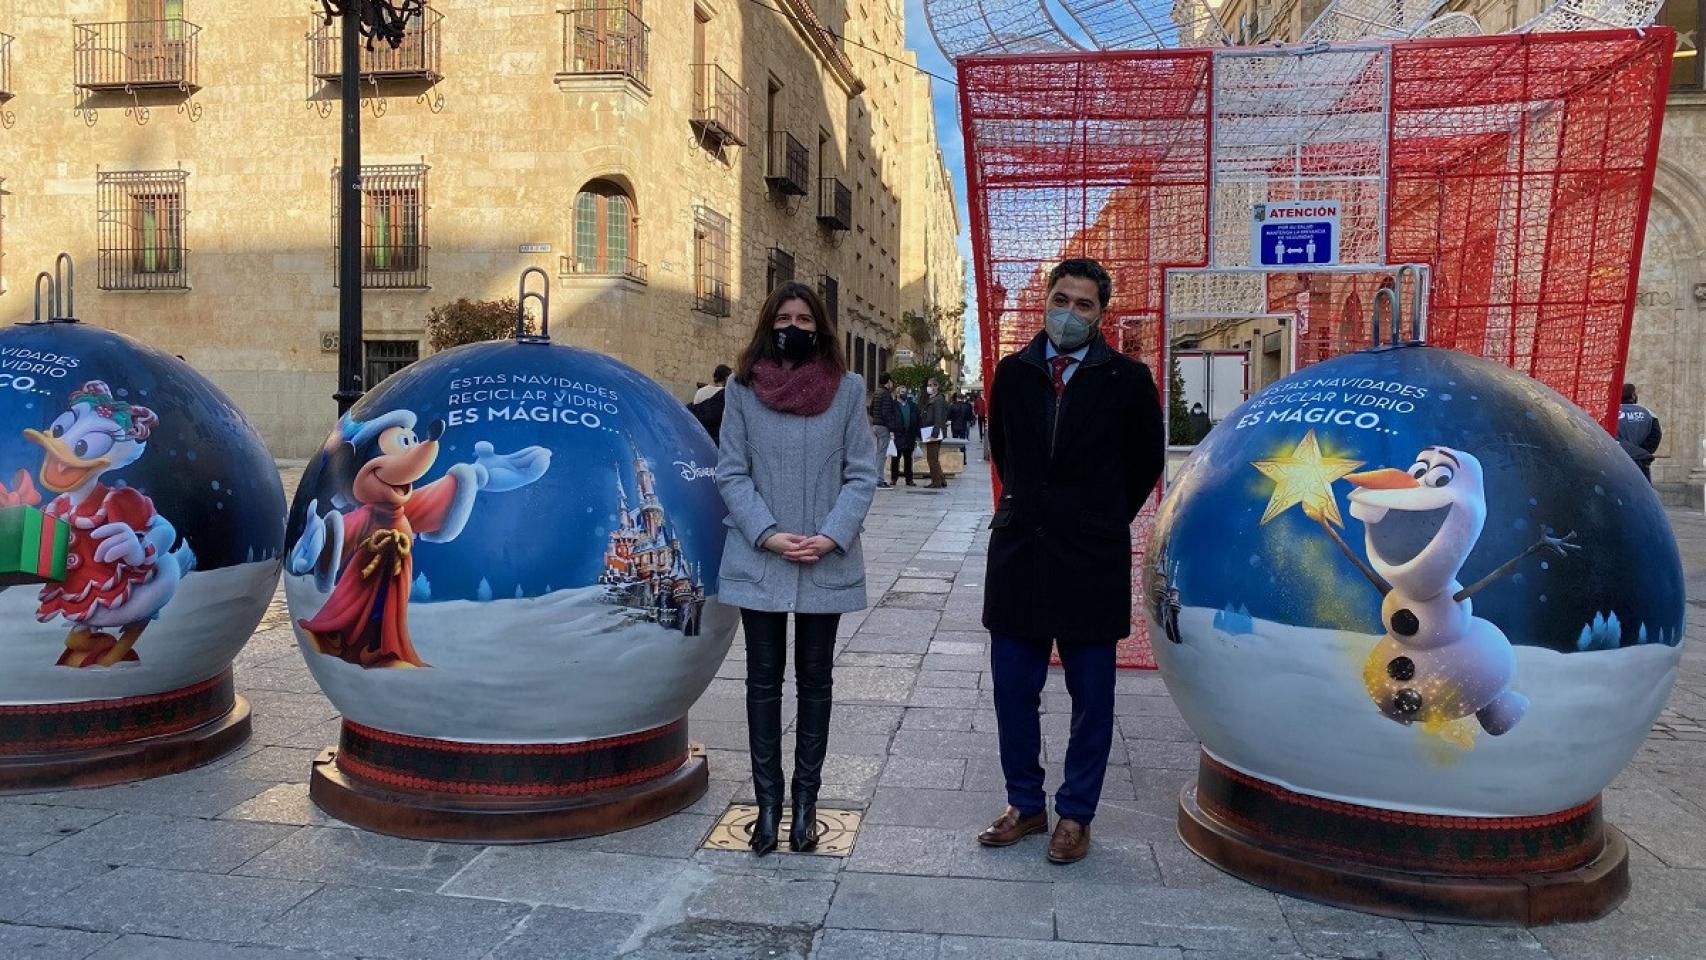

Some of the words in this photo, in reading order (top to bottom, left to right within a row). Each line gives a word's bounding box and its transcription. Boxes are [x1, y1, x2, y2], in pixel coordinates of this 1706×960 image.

[1269, 206, 1336, 218] ATENCIÓN
[2, 359, 67, 378] VIDRIO
[450, 373, 507, 390] ESTAS
[513, 374, 618, 401] NAVIDADES
[1263, 379, 1312, 397] ESTAS
[1312, 377, 1429, 399] NAVIDADES
[448, 388, 547, 406] RECICLAR
[553, 392, 618, 415] VIDRIO
[1251, 392, 1337, 409] RECICLAR
[1344, 393, 1415, 414] VIDRIO
[448, 408, 479, 427] ES
[488, 401, 620, 434] MÁGICO...
[1235, 411, 1264, 430] ES
[1265, 402, 1398, 435] MÁGICO...
